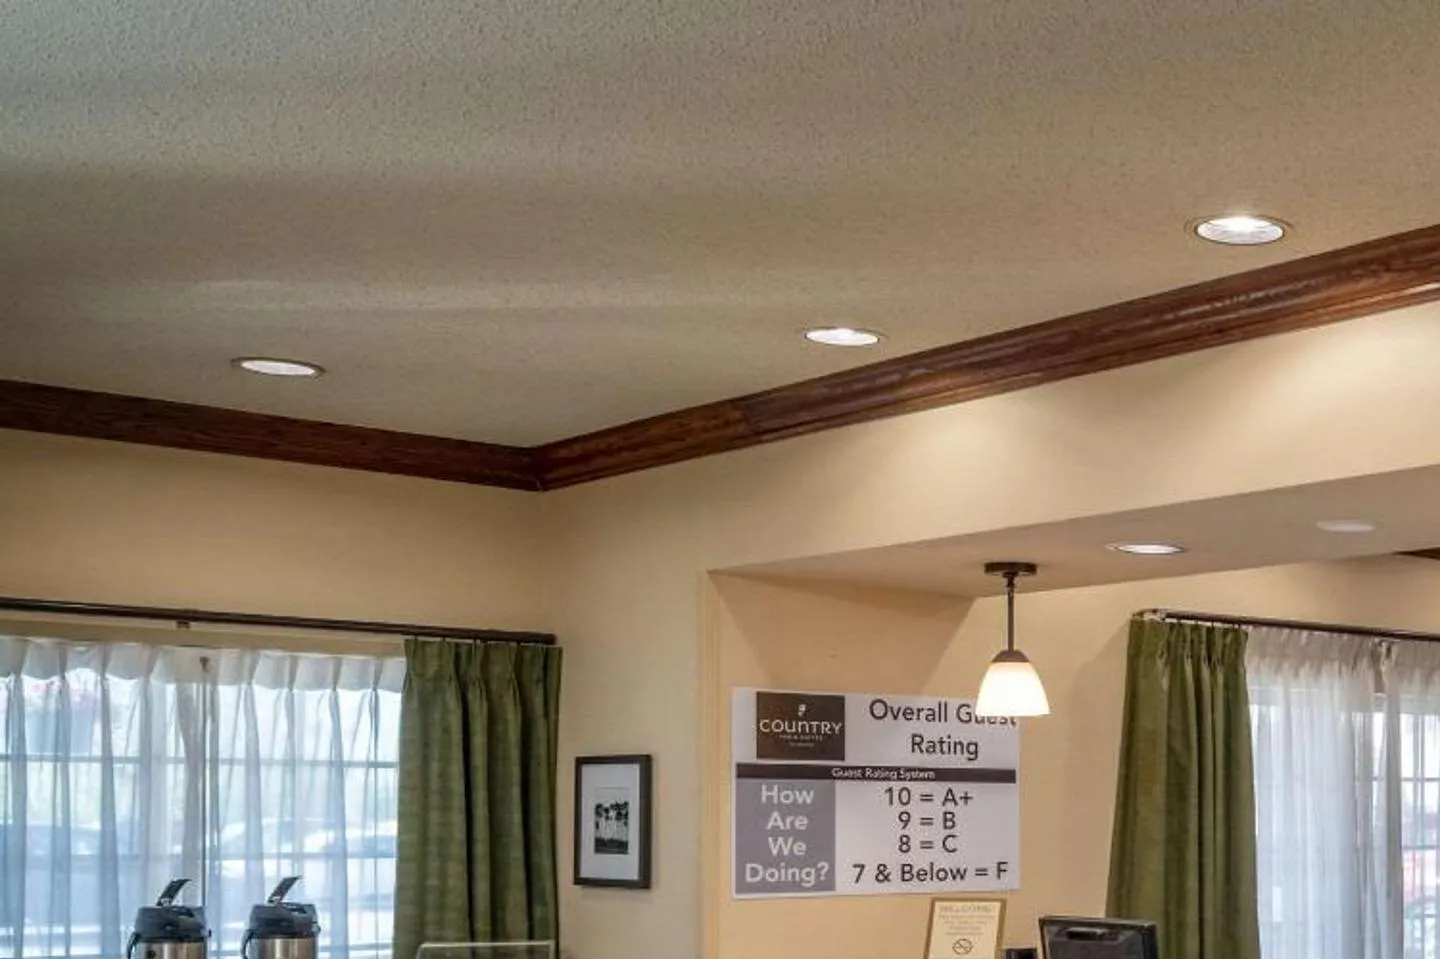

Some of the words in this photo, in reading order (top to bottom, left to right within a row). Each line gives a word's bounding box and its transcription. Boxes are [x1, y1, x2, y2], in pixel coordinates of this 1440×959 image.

[869, 699, 948, 723] Overall
[760, 719, 842, 735] COUNTRY
[911, 733, 979, 761] Rating
[831, 767, 862, 778] Guest
[865, 767, 897, 780] Rating
[899, 767, 936, 780] System
[761, 785, 814, 805] How
[885, 787, 912, 806] 10
[920, 792, 934, 802] =
[942, 787, 974, 807] A+
[767, 811, 809, 831] Are
[897, 811, 912, 830] 9
[920, 817, 934, 826] =
[942, 811, 956, 830] B
[768, 836, 807, 857] We
[897, 834, 912, 854] 8
[920, 841, 934, 850] =
[942, 834, 959, 854] C
[745, 861, 829, 887] Doing?
[852, 864, 866, 884] 7
[875, 863, 892, 883] &
[901, 861, 968, 883] Below
[975, 868, 989, 878] =
[996, 861, 1009, 880] F
